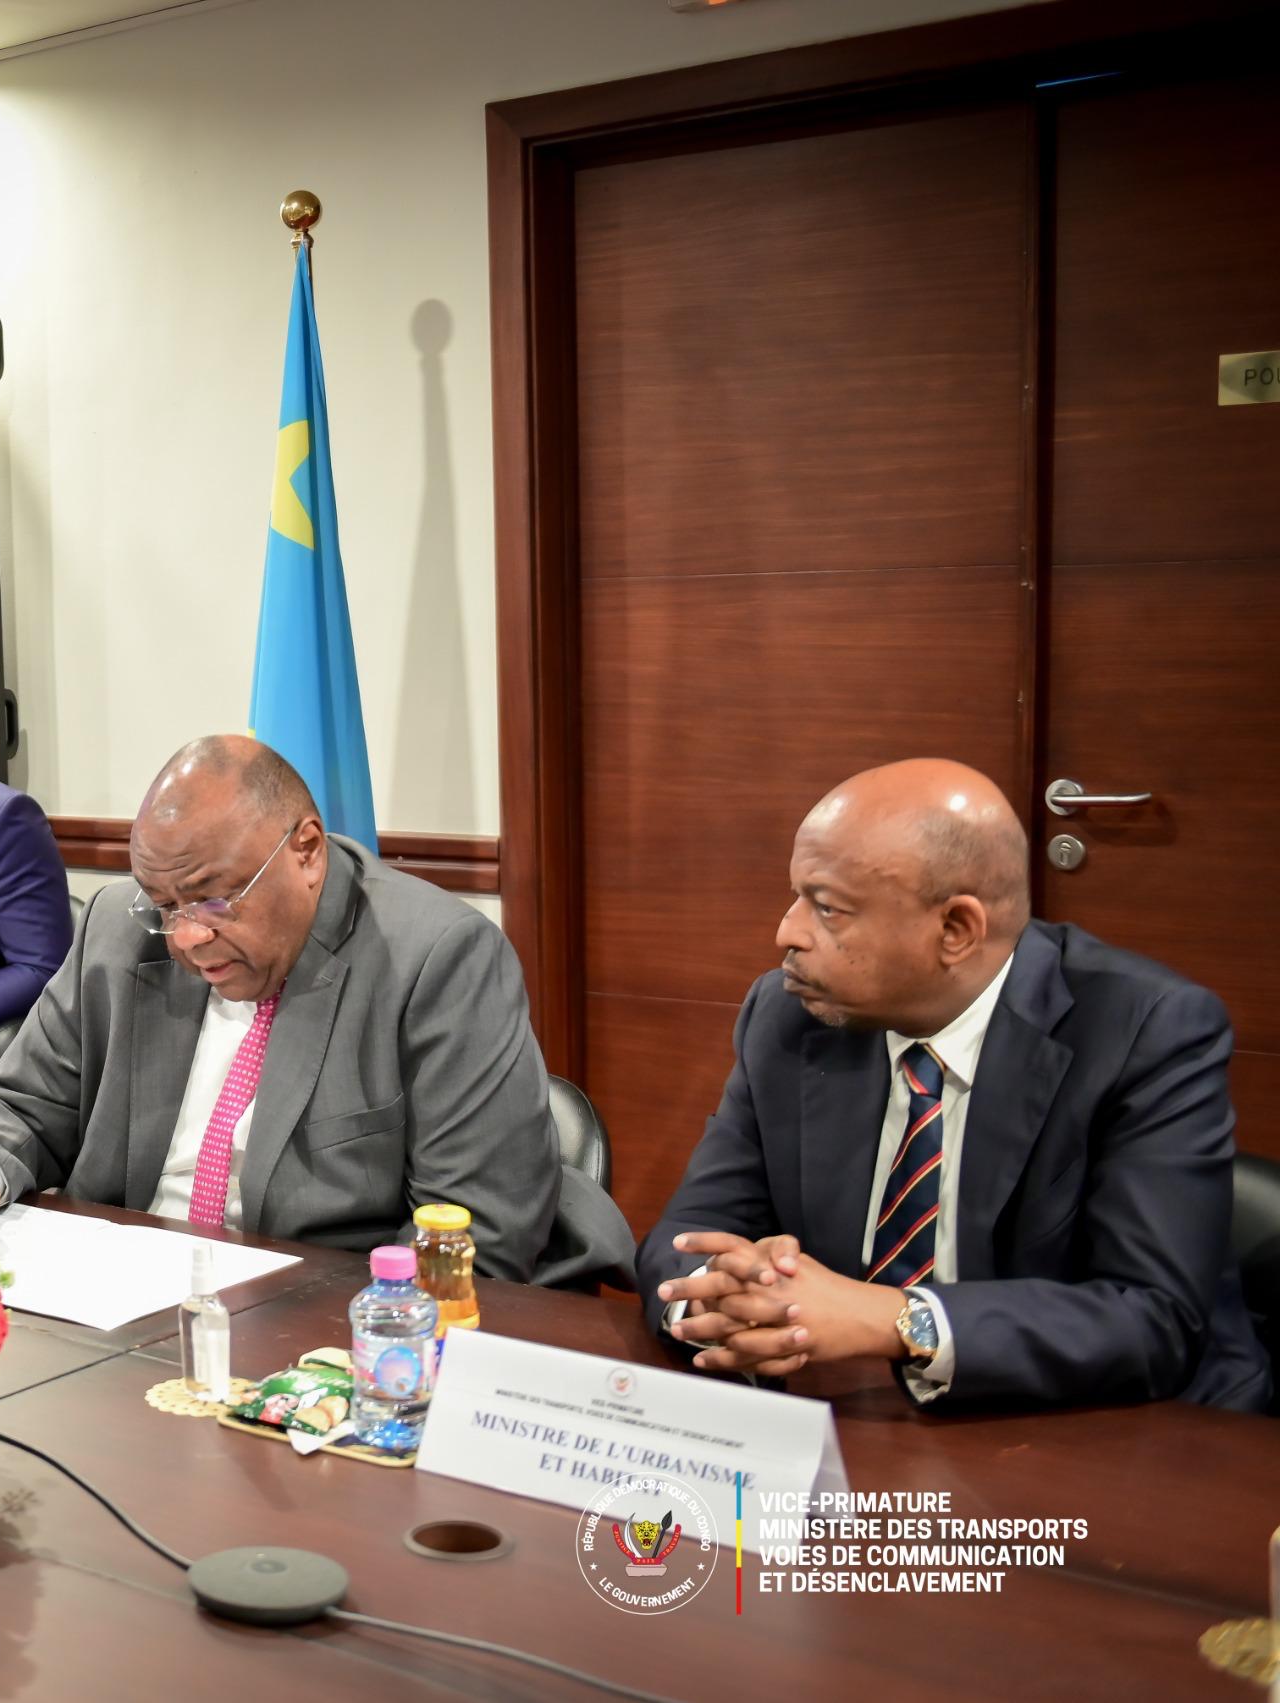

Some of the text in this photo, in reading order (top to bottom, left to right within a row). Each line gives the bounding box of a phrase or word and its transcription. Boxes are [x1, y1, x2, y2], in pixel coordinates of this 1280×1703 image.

[471, 1410, 757, 1490] MINISTRE DE L'URBANISME
[538, 1452, 567, 1473] ET
